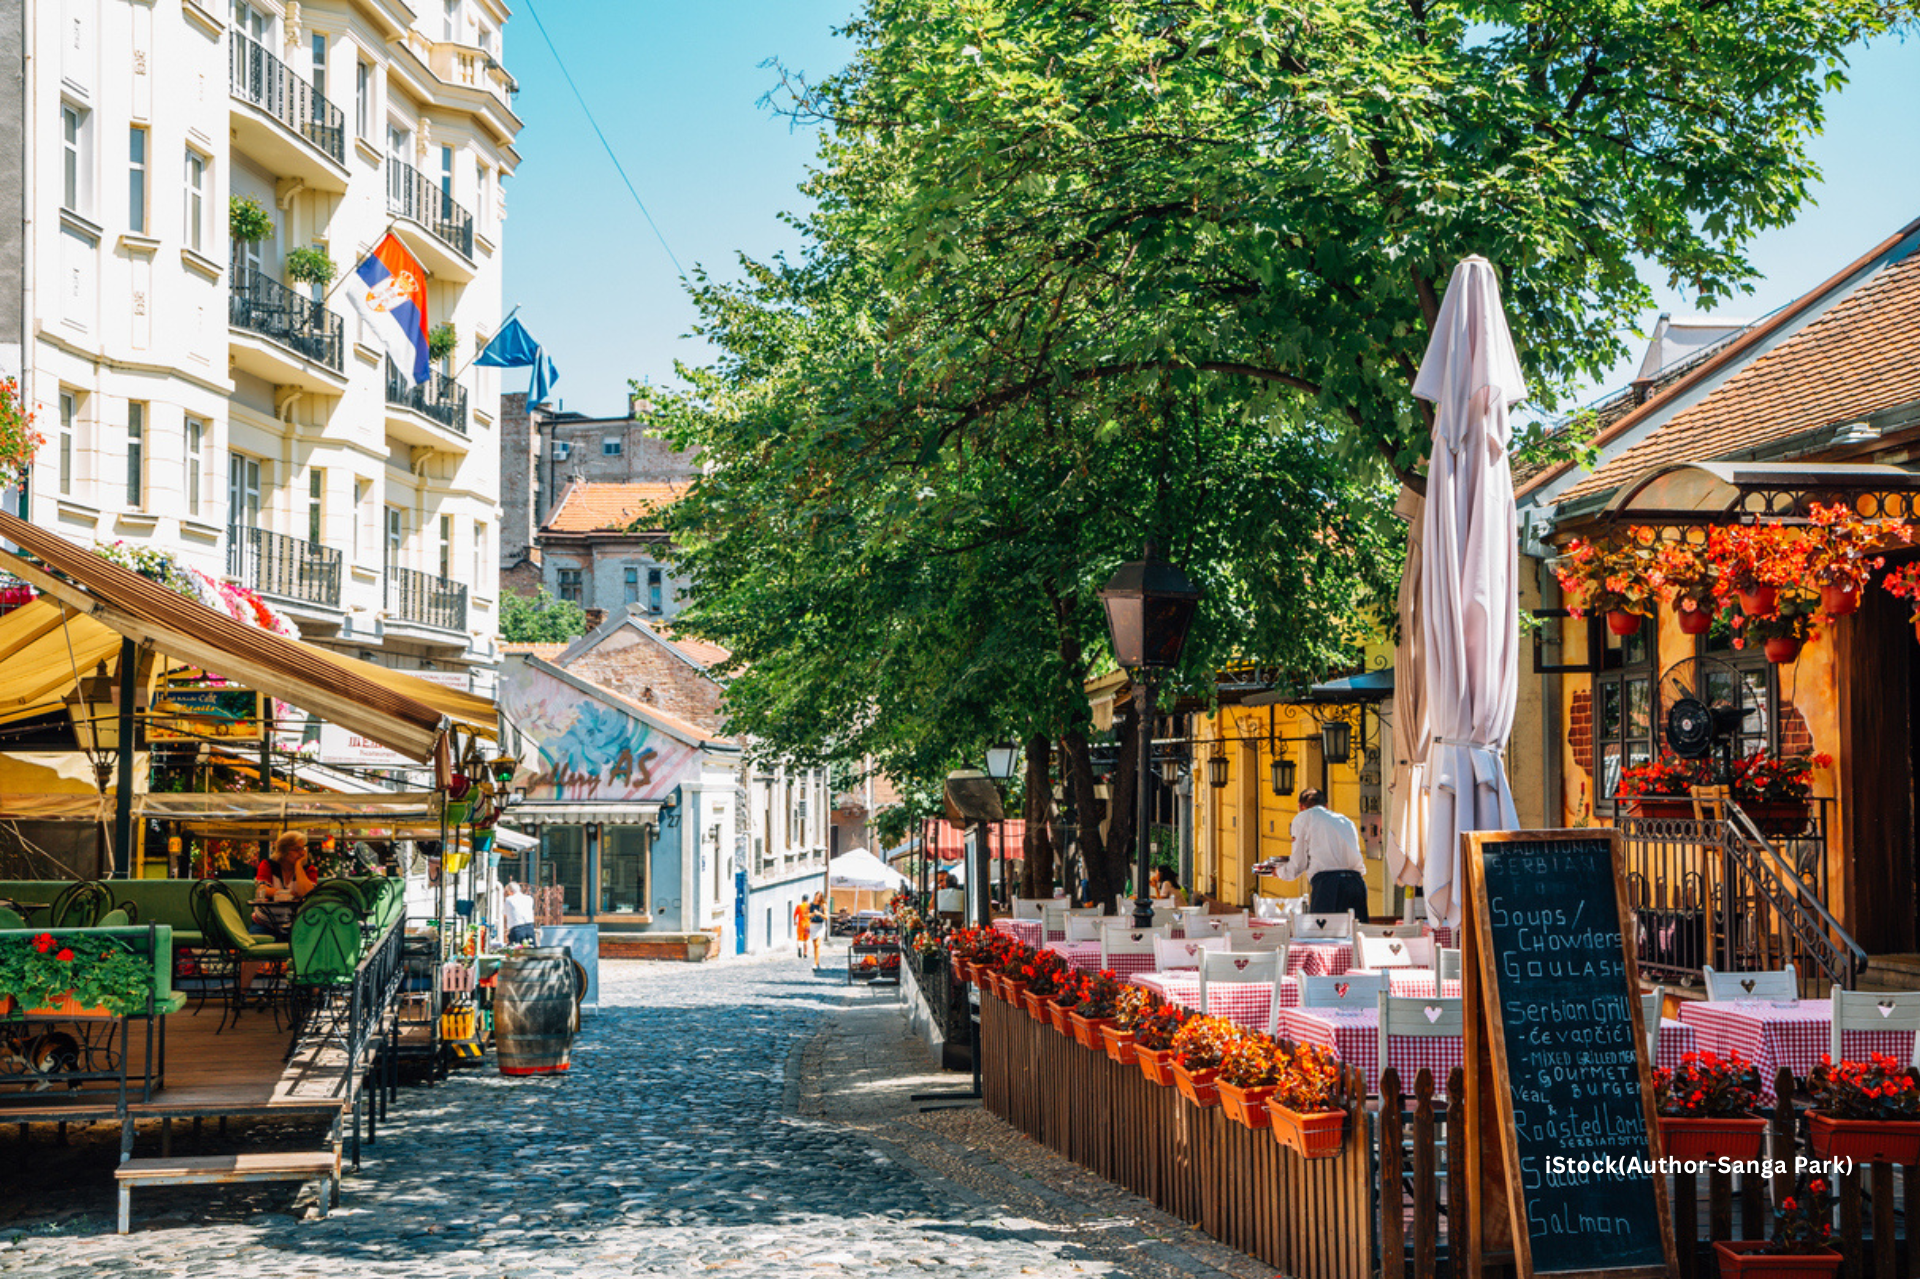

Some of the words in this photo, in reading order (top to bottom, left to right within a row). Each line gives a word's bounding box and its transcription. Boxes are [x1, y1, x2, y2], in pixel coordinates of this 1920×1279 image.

[527, 762, 601, 795] gallery
[608, 749, 657, 788] AS
[667, 814, 681, 828] 27
[1506, 1000, 1589, 1025] Serbian
